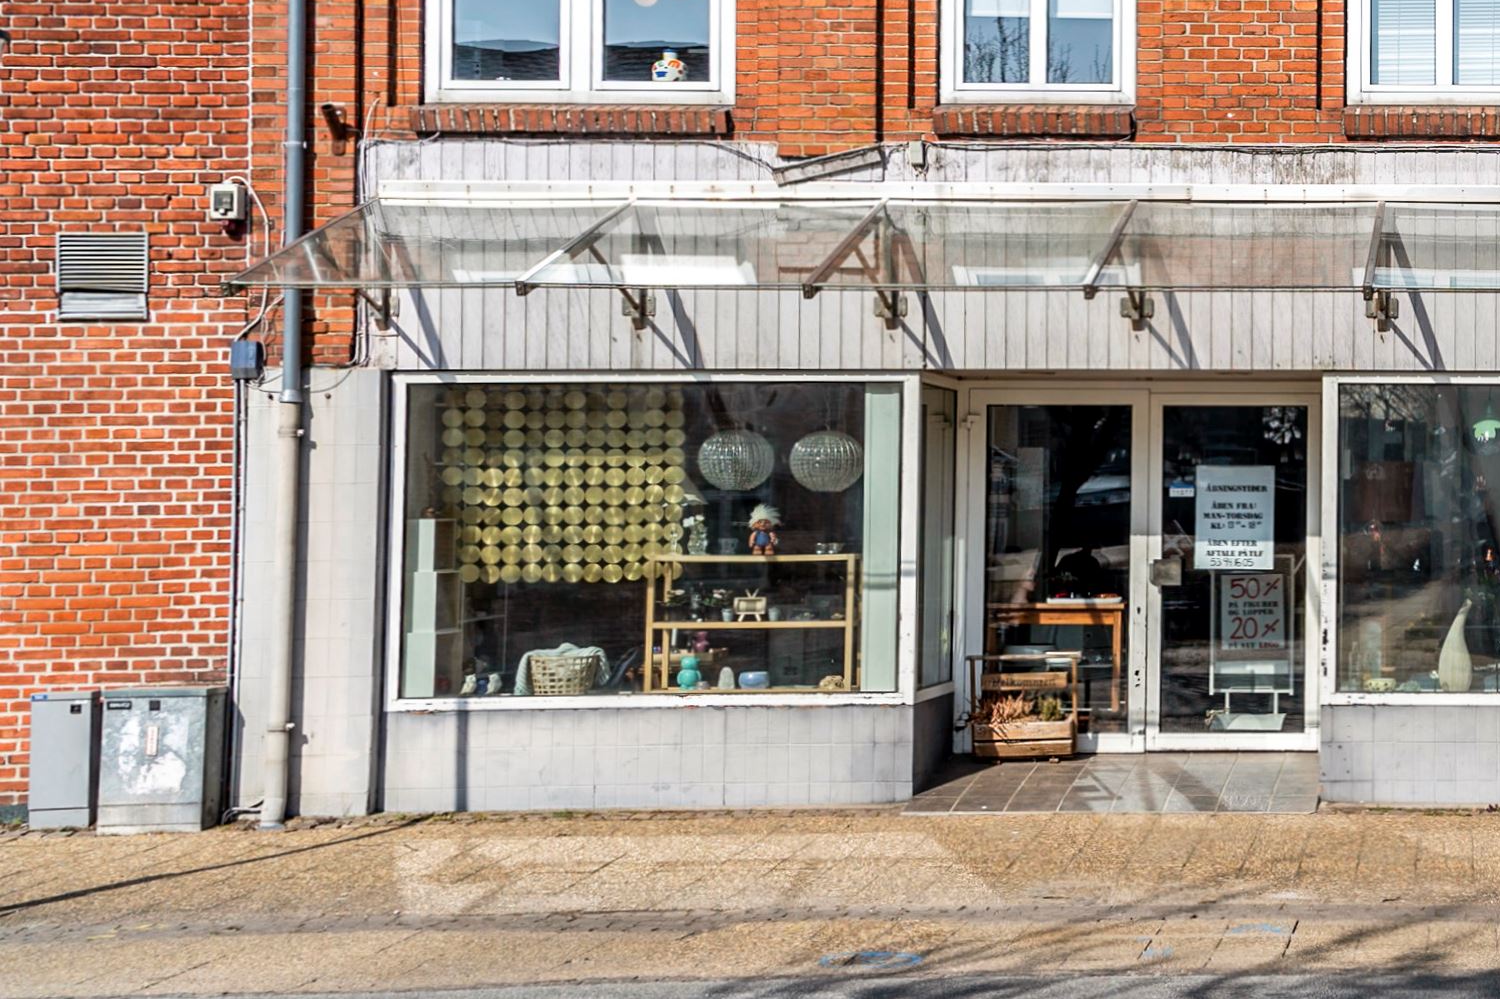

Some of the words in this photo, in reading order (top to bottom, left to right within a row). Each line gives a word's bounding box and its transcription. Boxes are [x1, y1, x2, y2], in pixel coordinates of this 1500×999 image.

[1205, 483, 1267, 492] ÅBNINGSTIDER
[1211, 500, 1233, 509] ÅBEN
[1207, 538, 1228, 547] ÅBEN
[1231, 539, 1257, 547] EFTER
